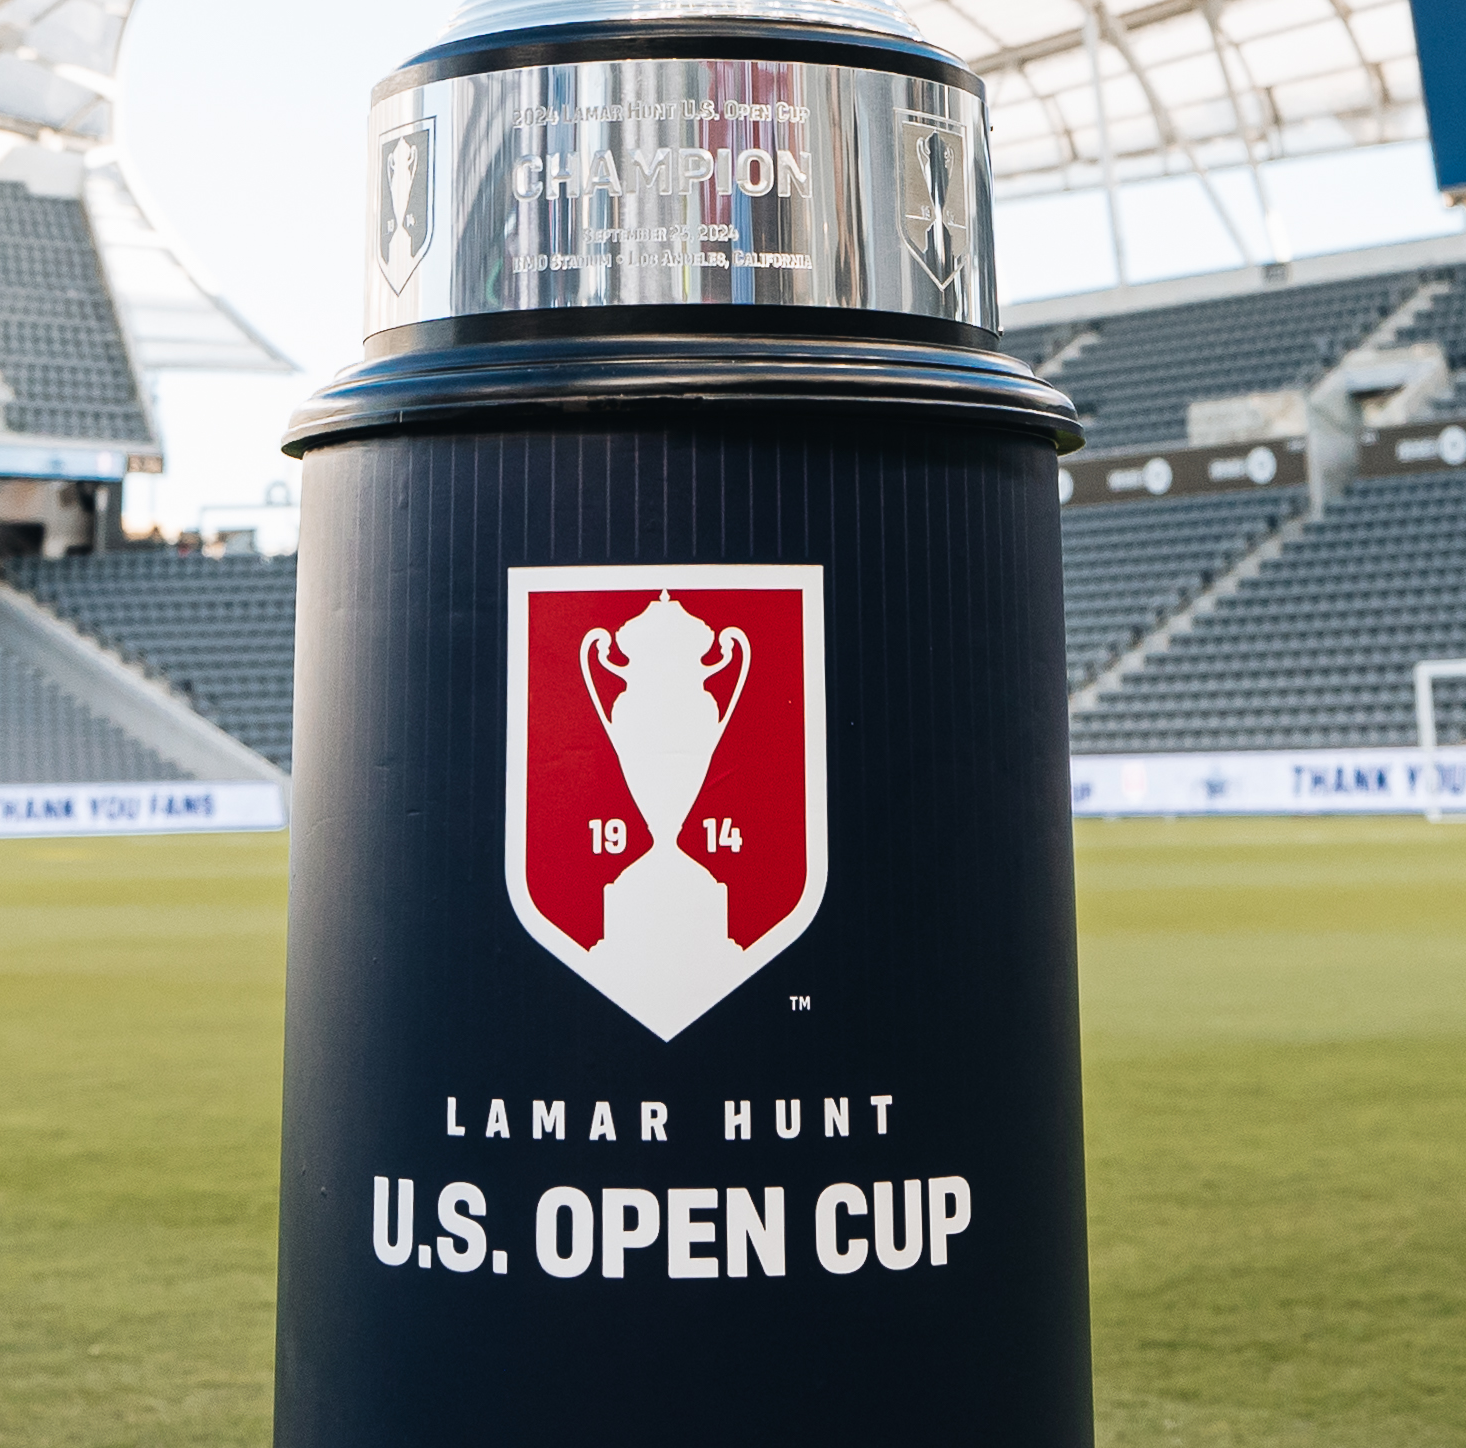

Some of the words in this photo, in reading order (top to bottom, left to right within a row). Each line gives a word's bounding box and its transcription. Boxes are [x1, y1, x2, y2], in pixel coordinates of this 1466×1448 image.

[512, 107, 559, 129] 2024
[561, 104, 623, 125] LAMAR
[627, 100, 676, 122] HUNT
[682, 100, 720, 121] U.S.
[724, 100, 773, 122] OPEN
[775, 102, 811, 124] CUP
[512, 148, 813, 201] CHAMPION
[697, 224, 739, 242] 2024
[550, 252, 612, 271] STADIUM
[628, 250, 658, 268] LOS
[733, 251, 813, 270] CALIFORNIA
[1292, 762, 1391, 797] THANK
[149, 792, 215, 818] FANS
[588, 818, 627, 855] 19
[703, 817, 743, 853] 14
[790, 996, 811, 1011] TM
[447, 1096, 668, 1142] LAMAR
[724, 1095, 893, 1141] HUNT
[372, 1175, 508, 1275] U.S.
[535, 1185, 786, 1280] OPEN
[815, 1175, 972, 1276] CUP
